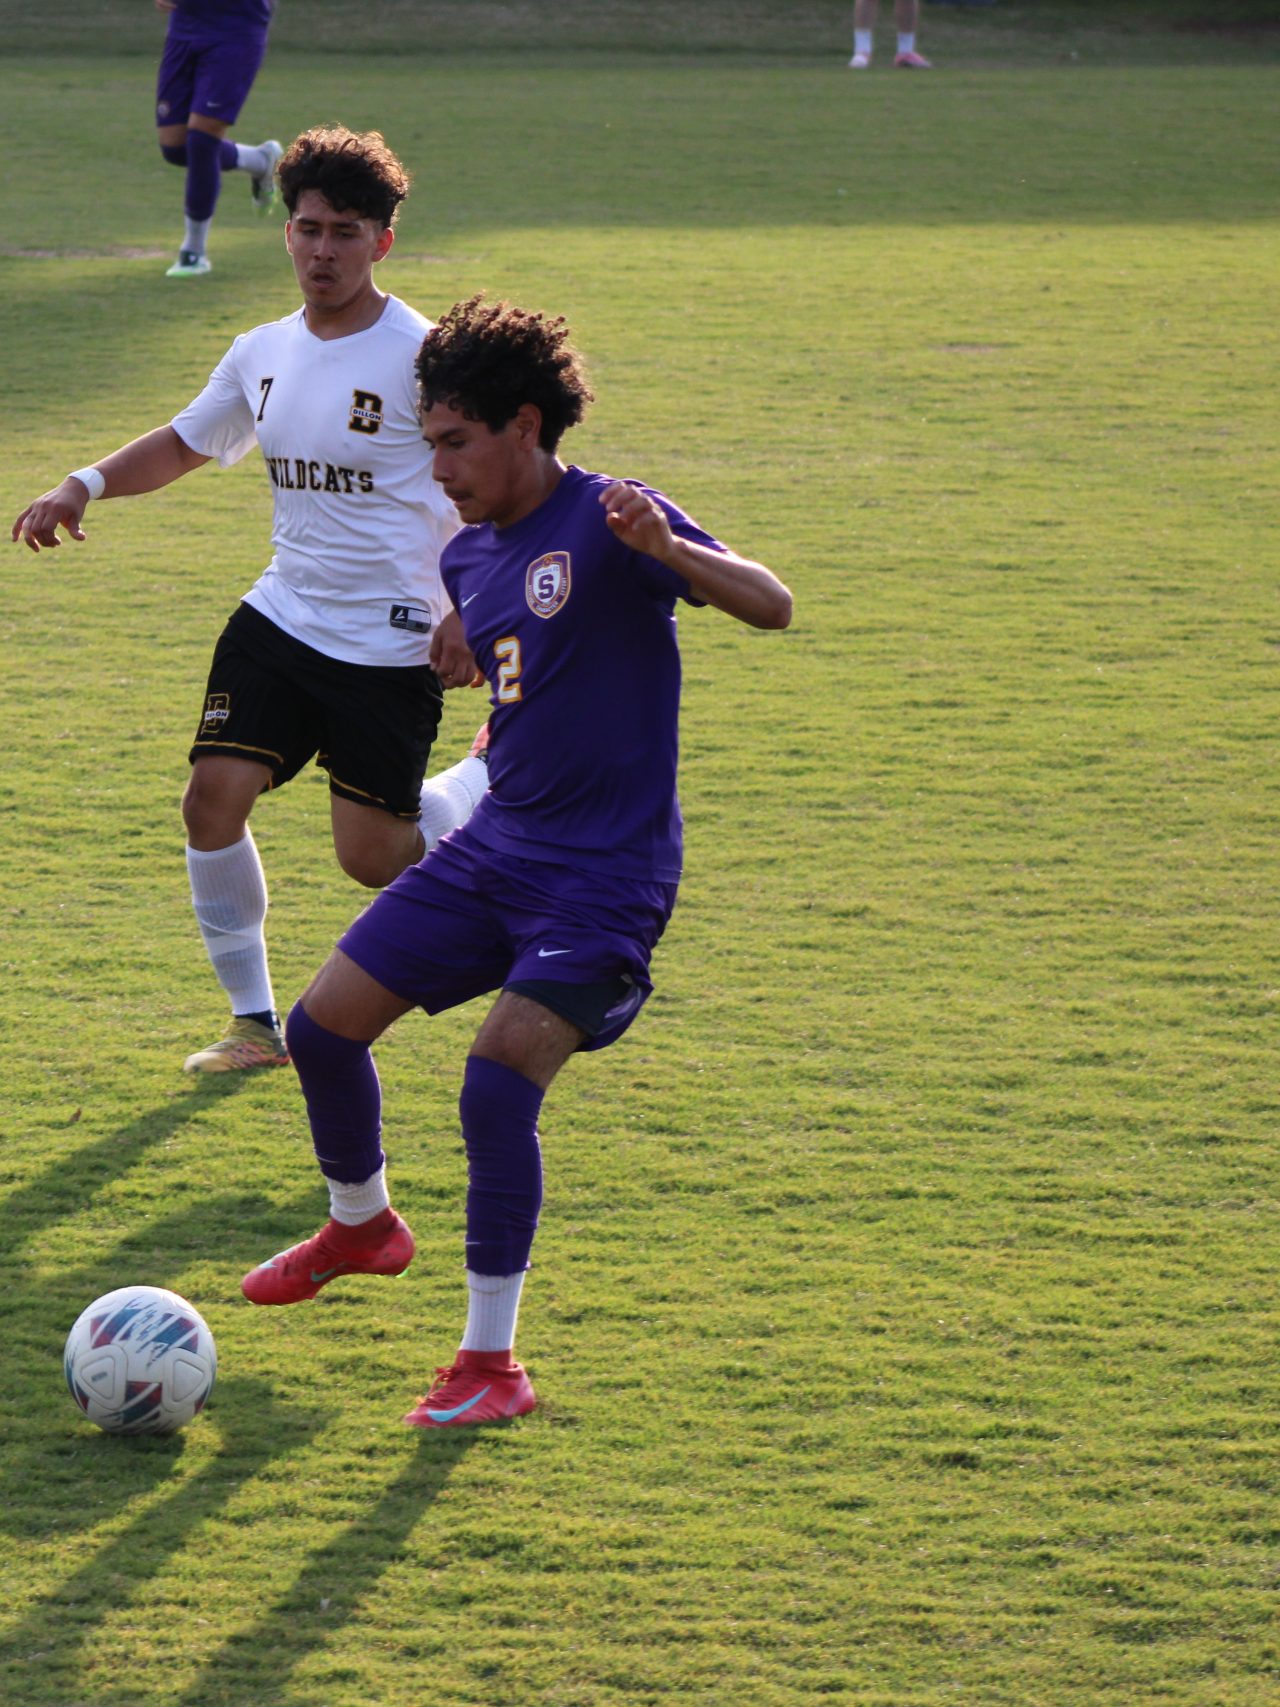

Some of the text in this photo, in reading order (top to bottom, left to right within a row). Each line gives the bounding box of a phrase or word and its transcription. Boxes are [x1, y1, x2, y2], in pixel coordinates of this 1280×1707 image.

[257, 377, 274, 422] 7
[348, 388, 383, 435] D
[352, 408, 382, 421] DILLON
[538, 573, 554, 600] S
[494, 635, 523, 703] 2
